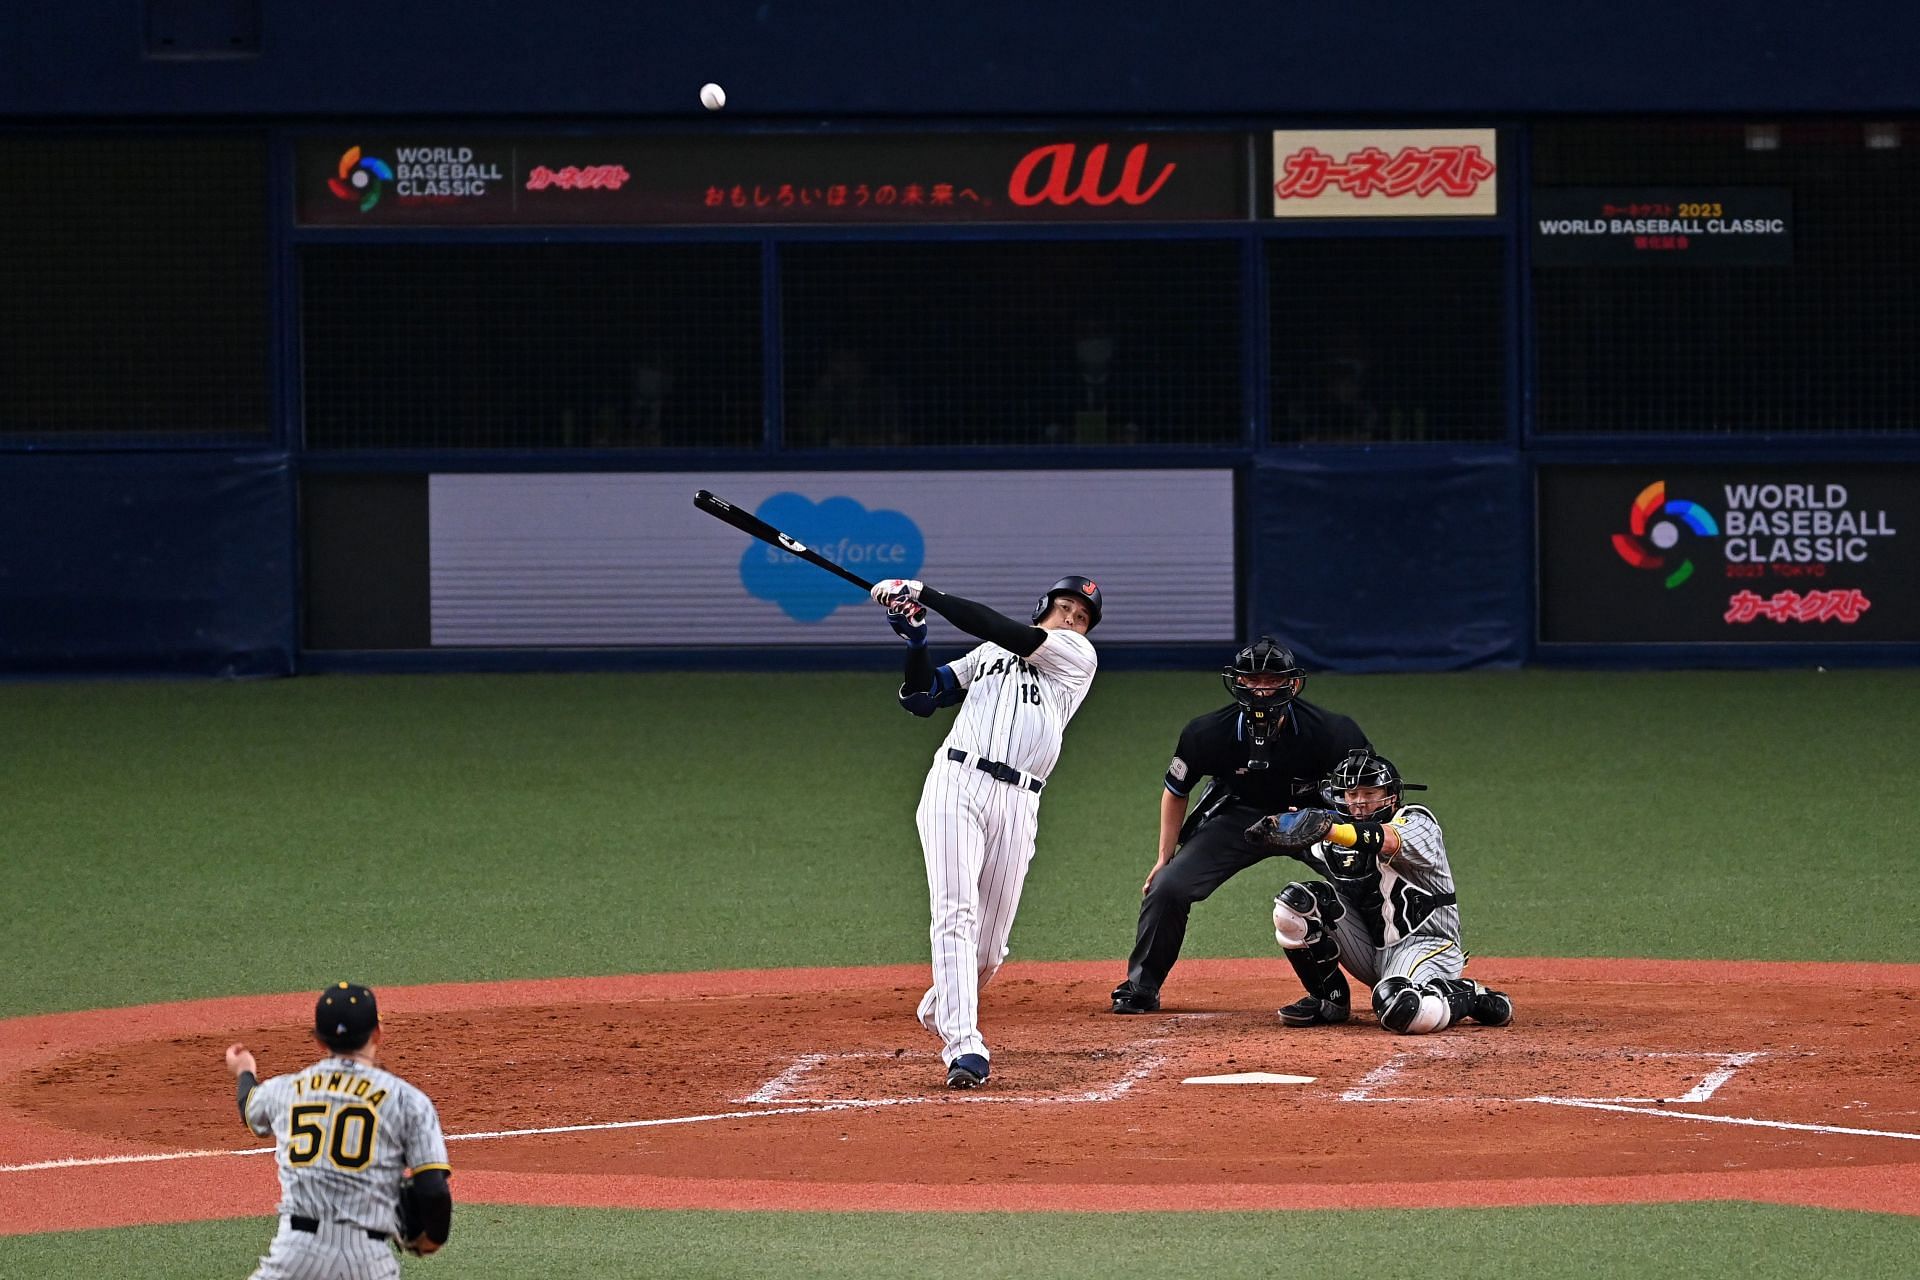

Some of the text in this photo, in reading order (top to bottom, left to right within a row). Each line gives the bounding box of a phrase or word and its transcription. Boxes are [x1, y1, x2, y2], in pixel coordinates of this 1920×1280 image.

[397, 148, 473, 164] WORLD
[397, 165, 502, 180] BASEBALL
[526, 165, 630, 190] カーネクスト
[1008, 143, 1176, 205] au
[1276, 146, 1495, 199] カーネクスト
[397, 180, 485, 196] CLASSIC
[1678, 203, 1723, 217] 2023
[1540, 219, 1784, 234] WORLD BASEBALL CLASSIC
[1724, 484, 1848, 508] WORLD
[1725, 511, 1896, 536] BASEBALL
[1724, 538, 1868, 562] CLASSIC
[1724, 590, 1871, 622] カーネクスト
[289, 1103, 379, 1171] 50
